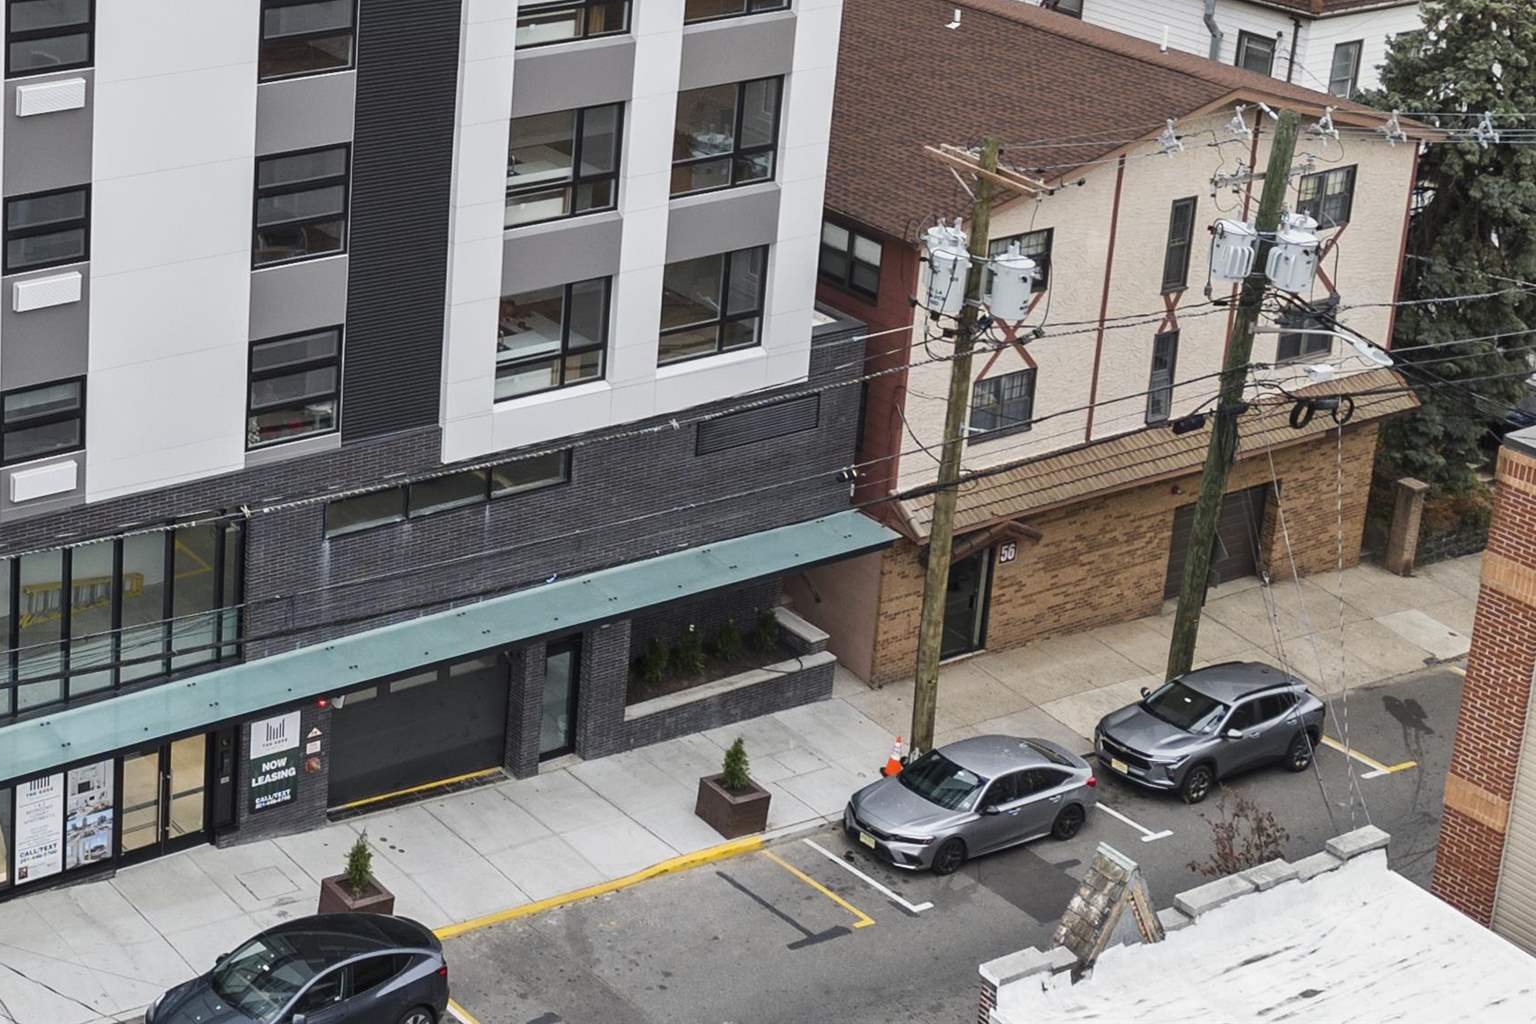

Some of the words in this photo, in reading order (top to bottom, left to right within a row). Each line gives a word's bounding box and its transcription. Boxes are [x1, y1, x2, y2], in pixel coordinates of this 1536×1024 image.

[1000, 543, 1016, 562] 56
[262, 757, 288, 772] NOW
[251, 767, 296, 788] LEASING
